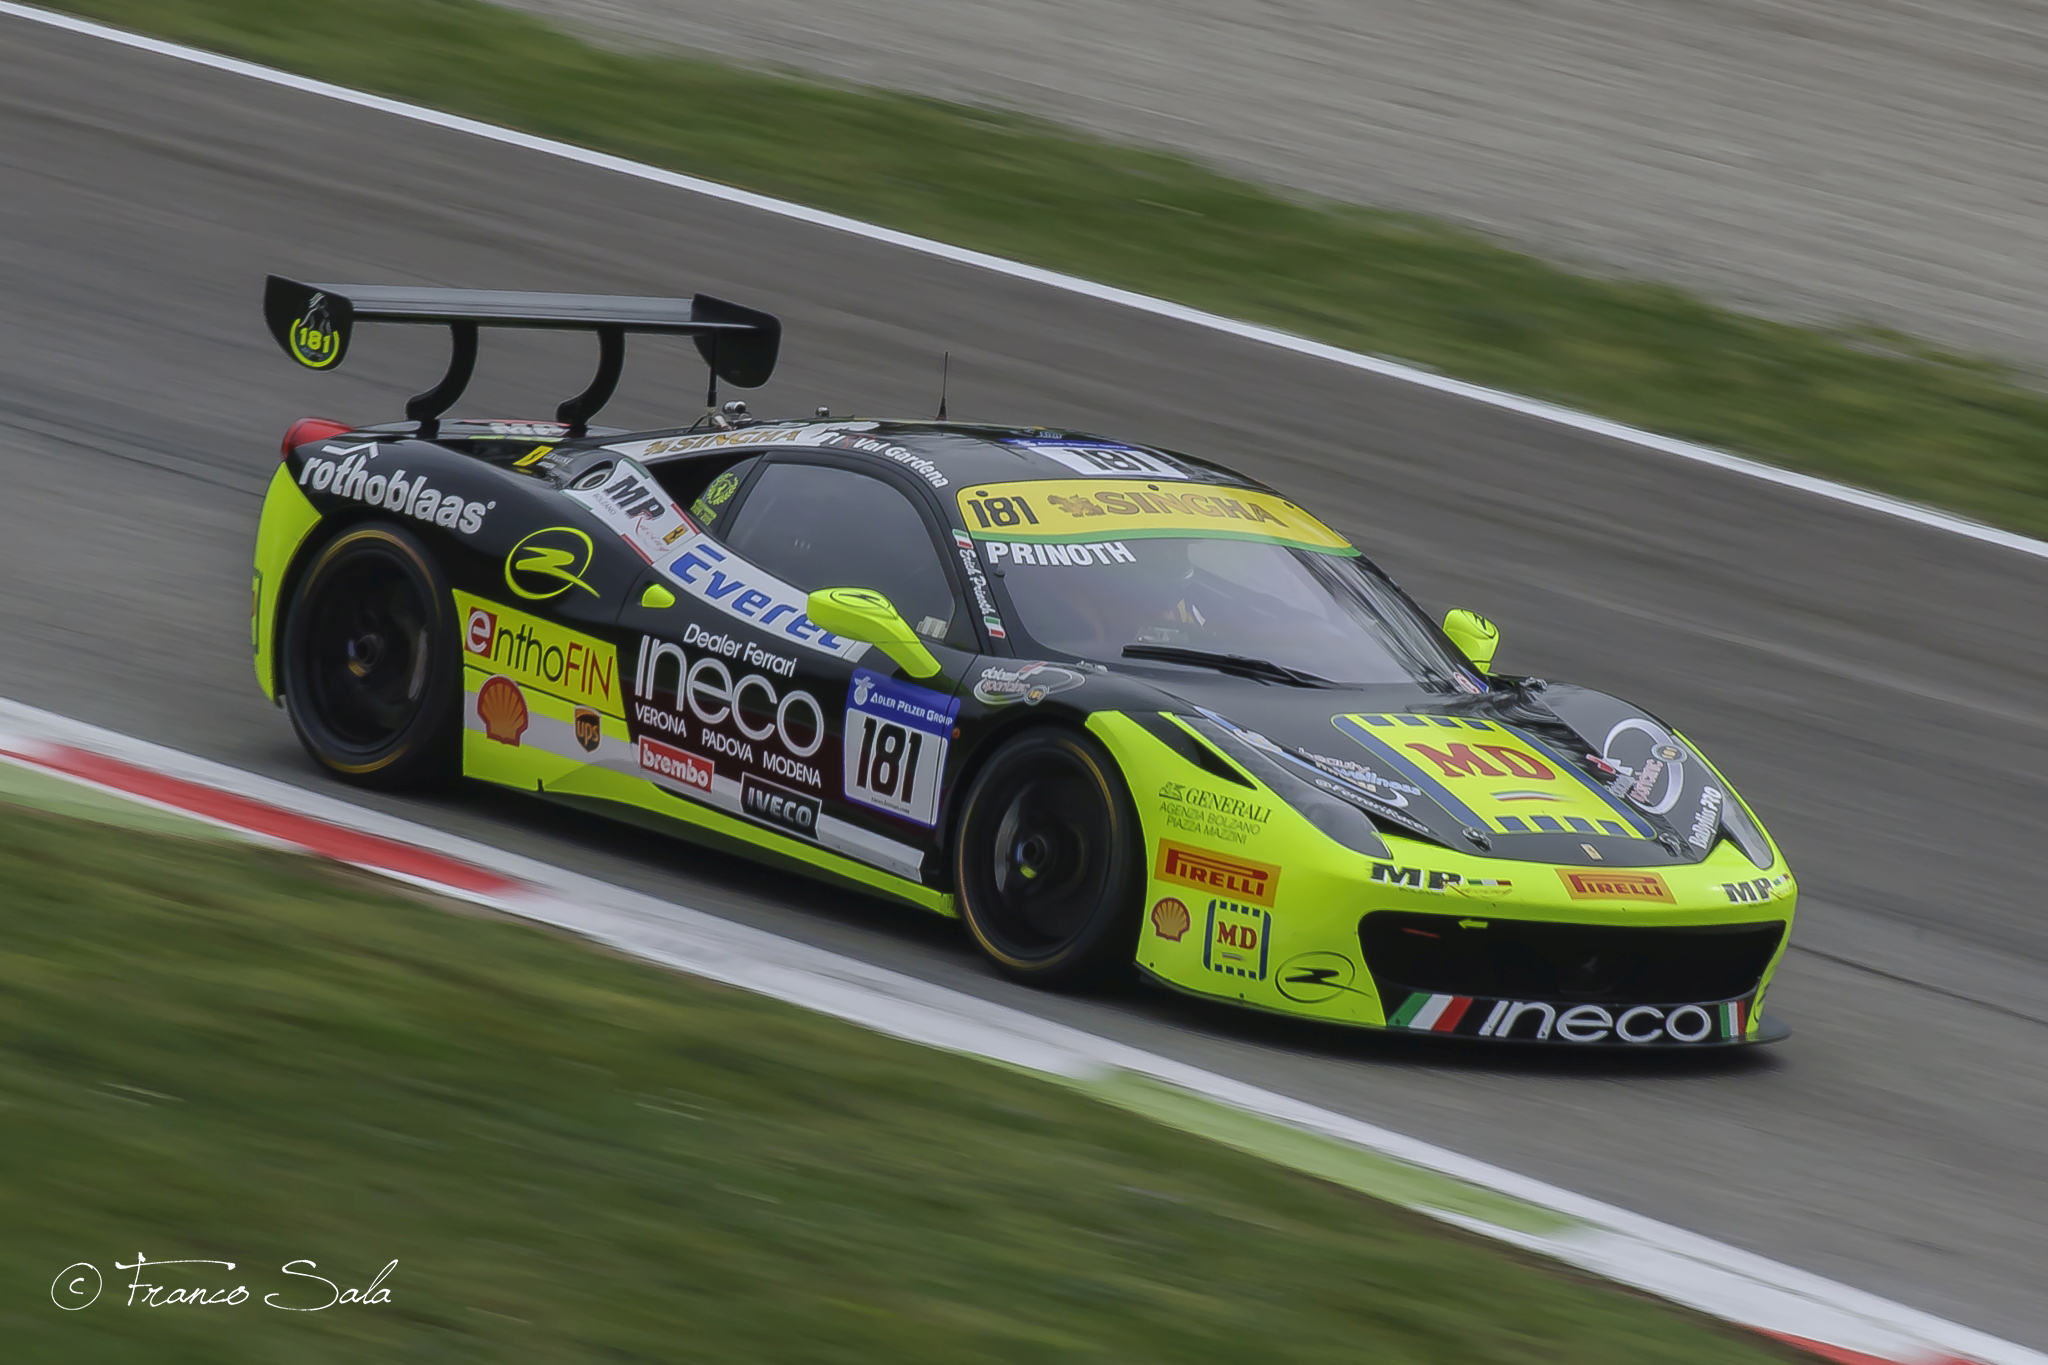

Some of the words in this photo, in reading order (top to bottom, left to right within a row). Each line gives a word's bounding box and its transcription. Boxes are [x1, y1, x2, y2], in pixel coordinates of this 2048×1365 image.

[300, 327, 331, 354] 181
[677, 429, 800, 452] SINGHA
[853, 437, 886, 453] Val
[884, 446, 950, 489] Gardena
[1063, 448, 1162, 473] 181
[299, 448, 487, 535] rothoblaas
[604, 474, 666, 522] MP
[967, 496, 1040, 528] 181
[1094, 491, 1290, 528] SINGHA
[959, 549, 982, 581] Erich
[985, 541, 1137, 568] PRINOTH
[970, 575, 996, 616] Prinoth
[466, 609, 614, 701] enthoFIN
[683, 622, 743, 660] Dealer
[742, 640, 798, 678] Ferrari
[870, 692, 896, 709] ADLER
[896, 699, 926, 718] PELZER
[926, 709, 953, 727] GROUP
[577, 720, 599, 747] ups
[635, 702, 687, 738] VERONA
[702, 728, 754, 764] PADOVA
[763, 751, 822, 789] MODENA
[642, 742, 710, 788] brembo
[856, 715, 923, 805] 181
[1405, 742, 1557, 780] MD
[1333, 766, 1422, 797] wellness
[747, 786, 812, 826] IVECO
[1159, 801, 1206, 821] AGENZIA
[1207, 811, 1261, 836] BOLZANO
[1186, 787, 1273, 824] GENERALI
[1166, 815, 1202, 835] PIAZZA
[1204, 824, 1248, 845] MAZZINI
[1165, 848, 1269, 897] PIRELLI
[1370, 862, 1464, 893] MP
[1569, 874, 1665, 898] PIRELLI
[1721, 877, 1774, 905] MP
[1216, 921, 1258, 950] MD
